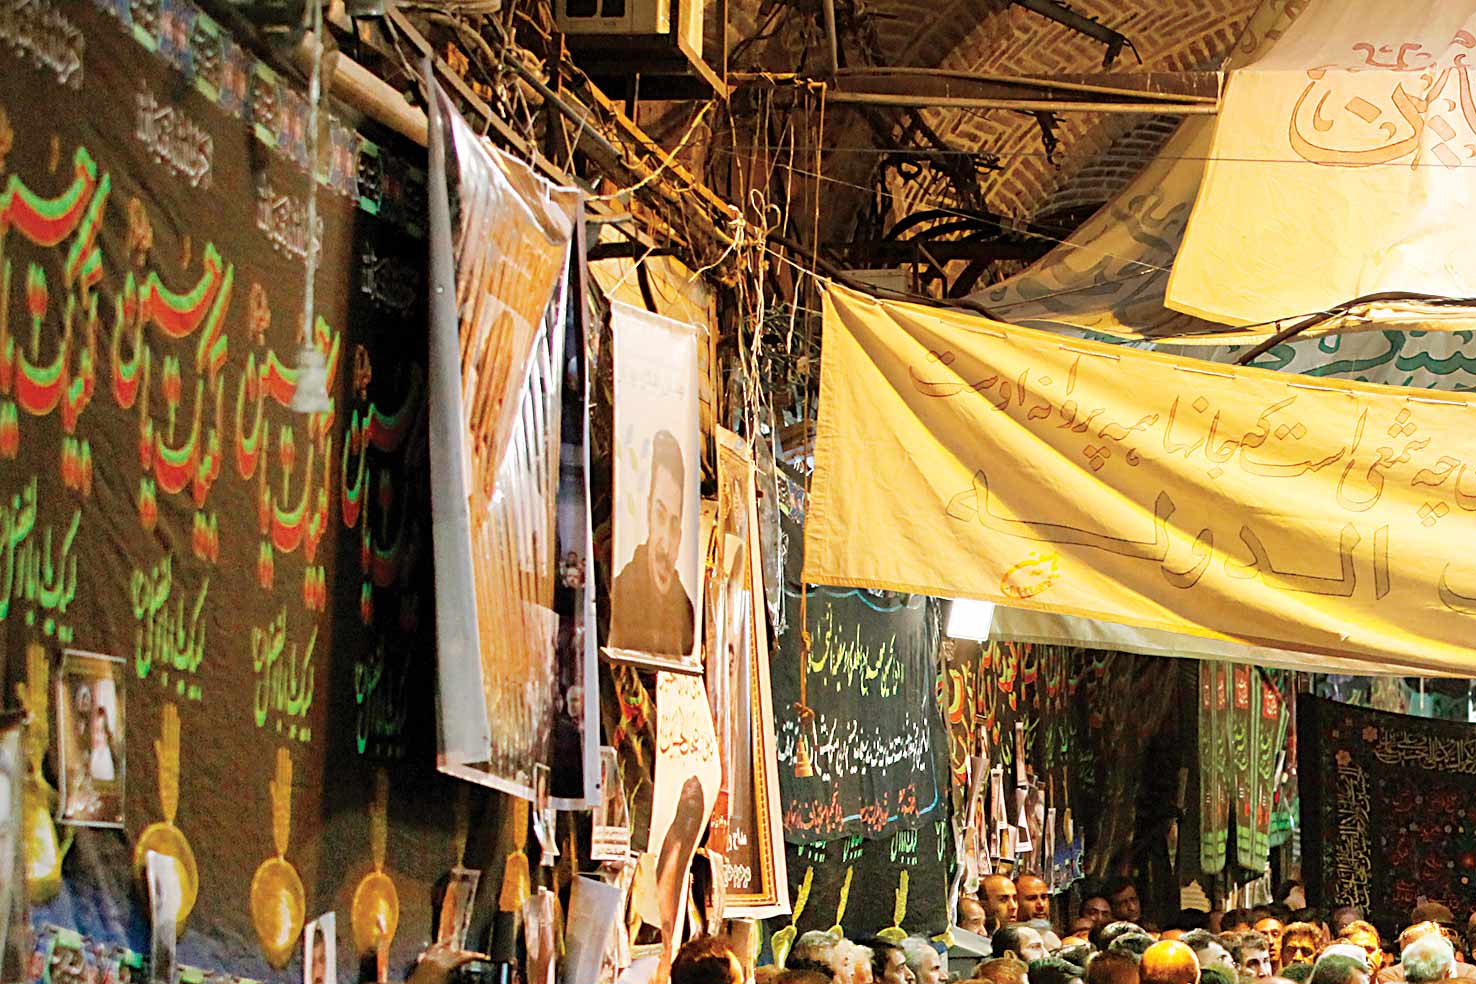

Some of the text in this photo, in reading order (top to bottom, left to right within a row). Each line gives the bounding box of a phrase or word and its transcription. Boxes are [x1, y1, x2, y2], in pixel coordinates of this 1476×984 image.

[908, 350, 1030, 412] اوست
[1028, 355, 1112, 473] پروانه
[1098, 413, 1160, 467] همه
[1164, 394, 1242, 480] جانها
[1239, 407, 1369, 478] است
[1240, 396, 1297, 449] که
[1336, 407, 1432, 513] شمعی
[1411, 455, 1461, 527] چه
